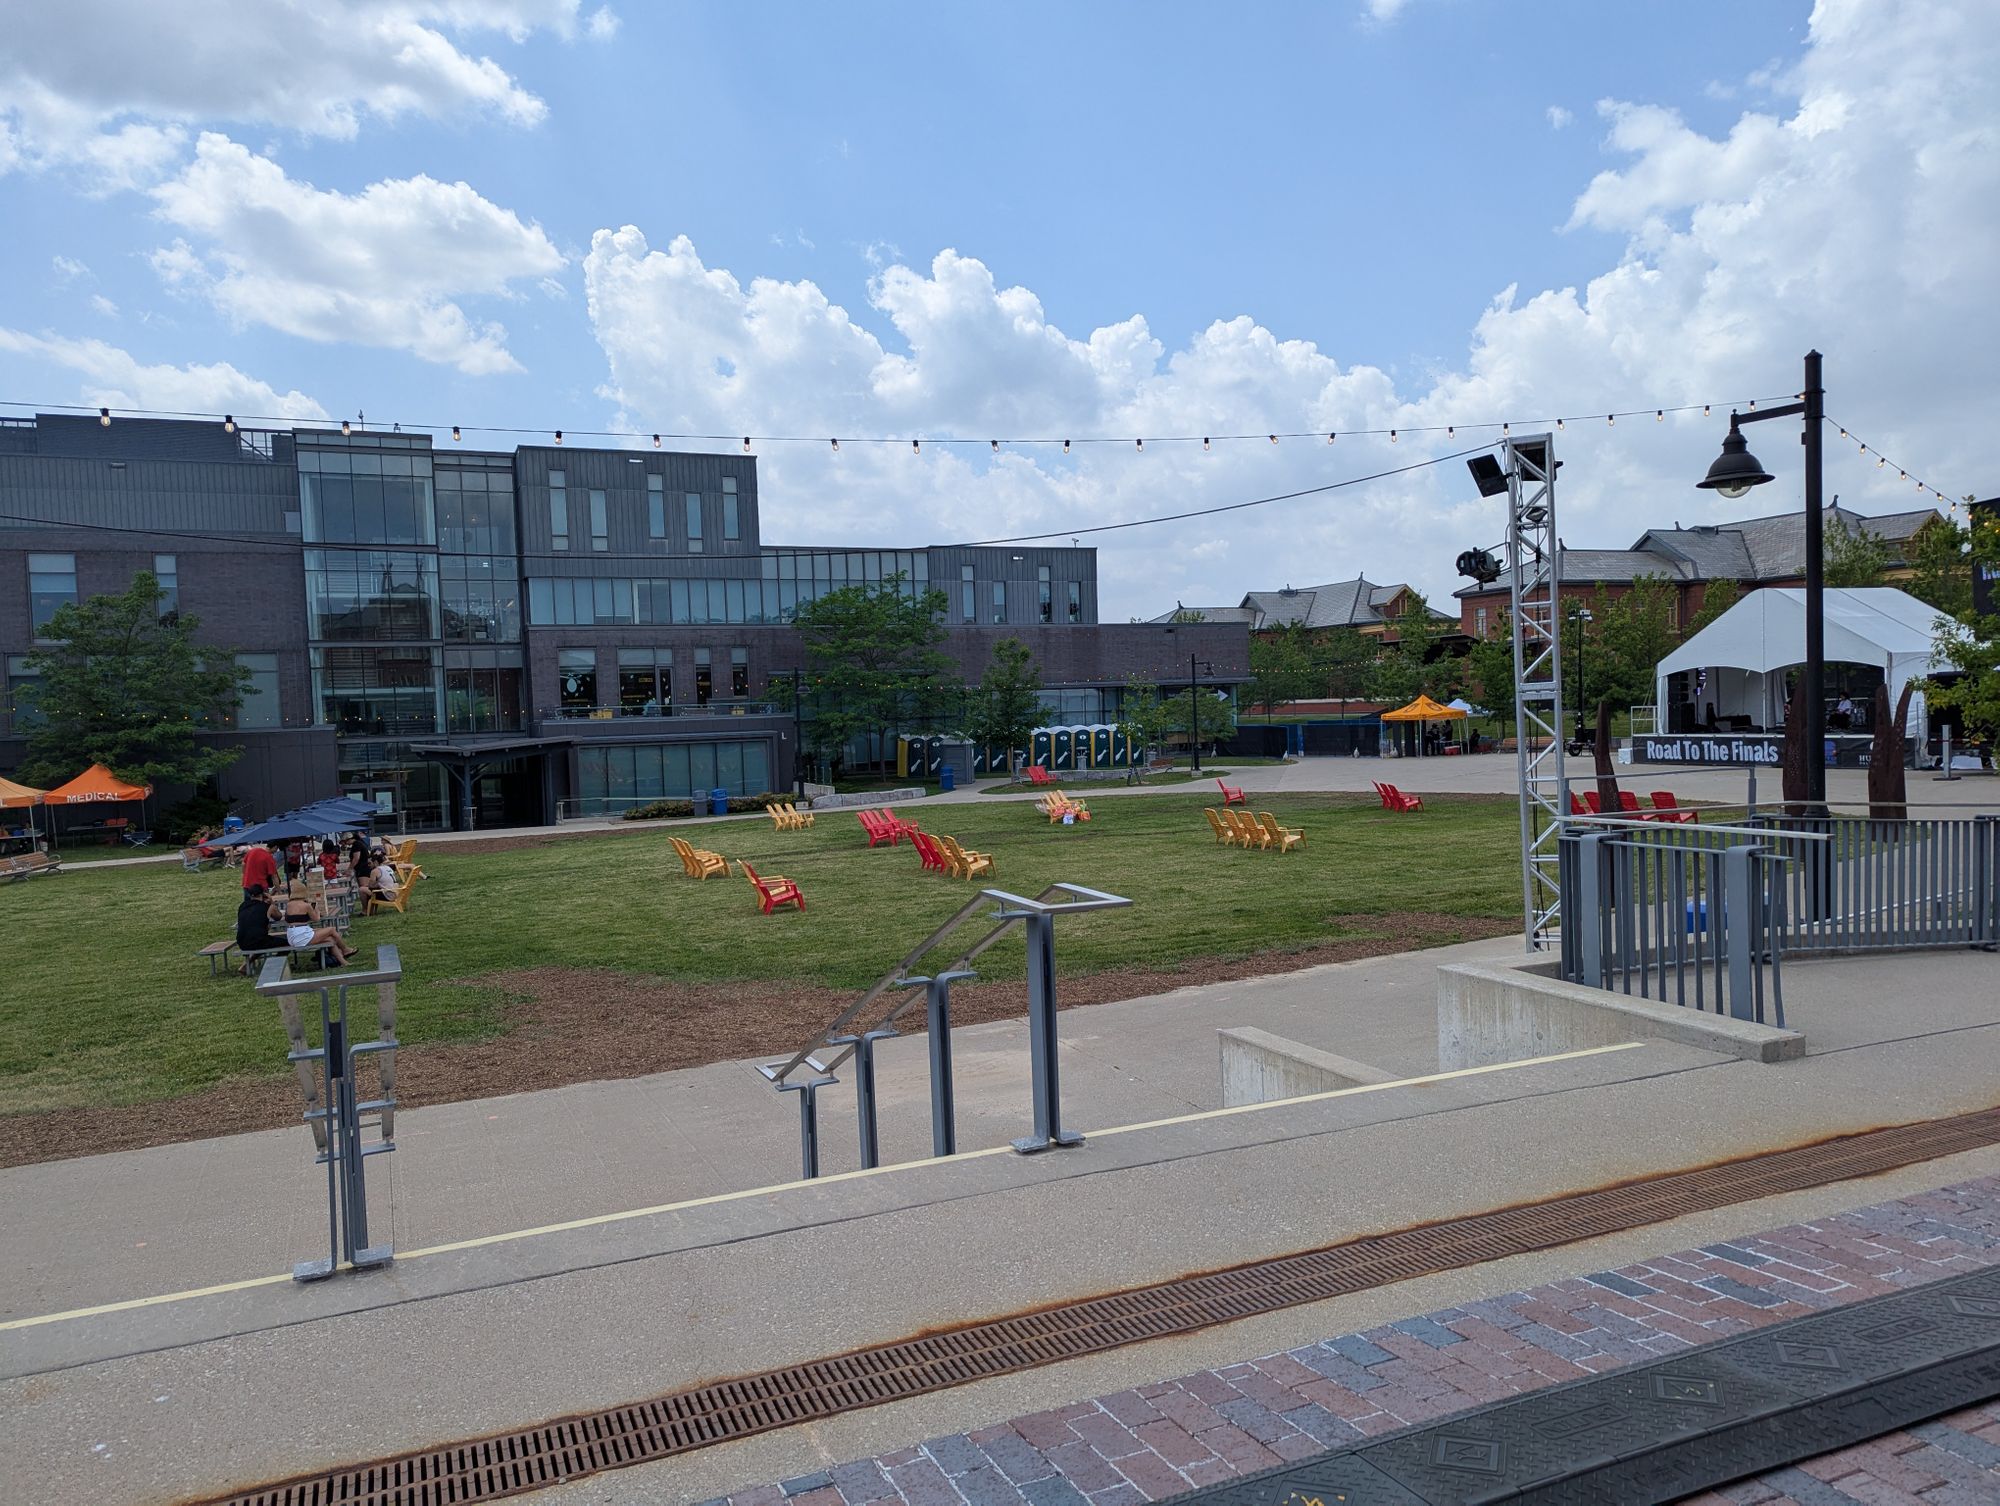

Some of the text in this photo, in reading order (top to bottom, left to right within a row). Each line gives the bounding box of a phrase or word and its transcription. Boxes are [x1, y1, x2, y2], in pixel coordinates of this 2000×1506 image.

[1646, 740, 1779, 762] Road To The Finals
[66, 791, 121, 804] MEDICAL
